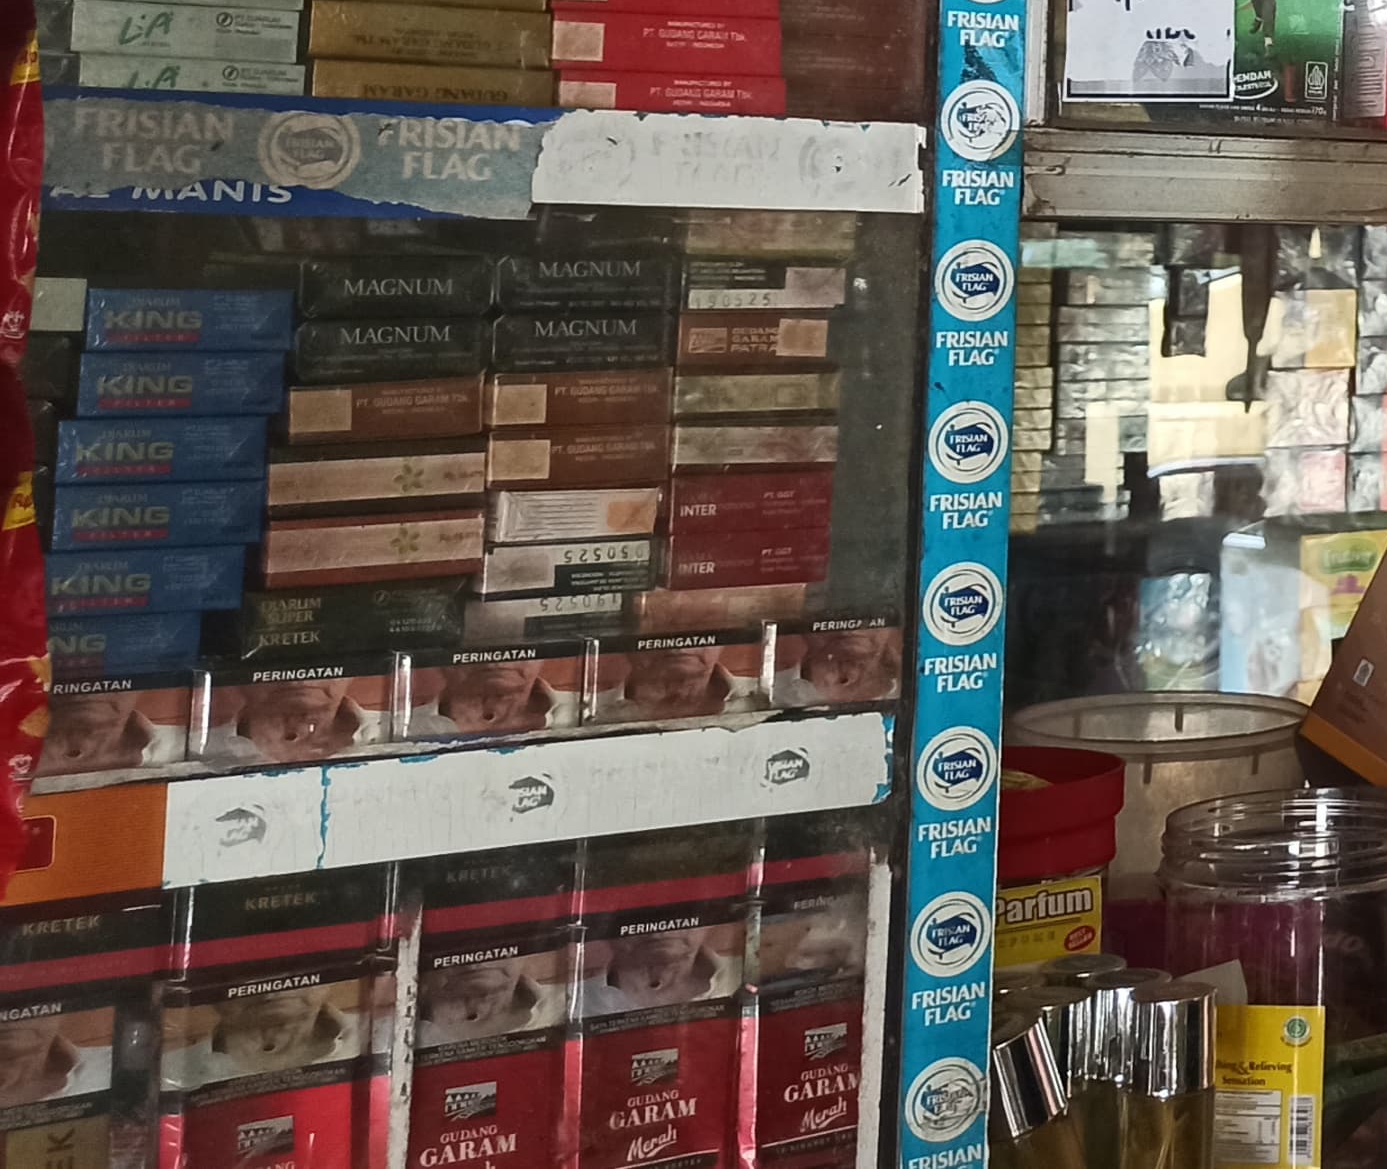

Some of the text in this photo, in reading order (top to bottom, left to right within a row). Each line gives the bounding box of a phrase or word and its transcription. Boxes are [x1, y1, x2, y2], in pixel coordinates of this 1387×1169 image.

[74, 107, 233, 142] FRISIAN
[377, 118, 522, 151] FRISIAN
[101, 142, 203, 176] FLAG
[402, 151, 493, 182] FLAG
[942, 170, 1014, 188] FRISIAN
[953, 186, 1001, 206] FLAG
[538, 260, 641, 279] MAGNUM
[955, 272, 994, 285] FRISIAN
[344, 277, 453, 297] MAGNUM
[962, 280, 988, 293] FLAG
[104, 310, 201, 329] KING
[340, 325, 450, 345] MAGNUM
[936, 331, 1008, 349] FRISIAN
[948, 348, 996, 367] FLAG
[680, 503, 717, 518] INTER
[678, 560, 716, 575] INTER
[51, 573, 152, 594] KING
[812, 618, 886, 631] PERINGAAN
[259, 631, 320, 646] KRETEK
[637, 635, 717, 650] PERINGATAN
[252, 666, 344, 681] PERINGATAN
[924, 653, 997, 674] FRISIAN
[53, 678, 133, 695] RINGATAN
[936, 672, 983, 693] FLAG
[917, 817, 991, 841] FRISIAN
[930, 837, 979, 859] FLAG
[620, 917, 700, 936] PERINGATAN
[433, 945, 518, 969] PERINGATAN
[227, 973, 321, 998] PERINGATAN
[800, 1063, 848, 1083] GUDANG
[783, 1071, 860, 1103] GARAM
[627, 1089, 679, 1108] GUDANG
[608, 1097, 697, 1130] GARAM
[800, 1097, 848, 1133] Merah
[625, 1126, 678, 1162] Merah
